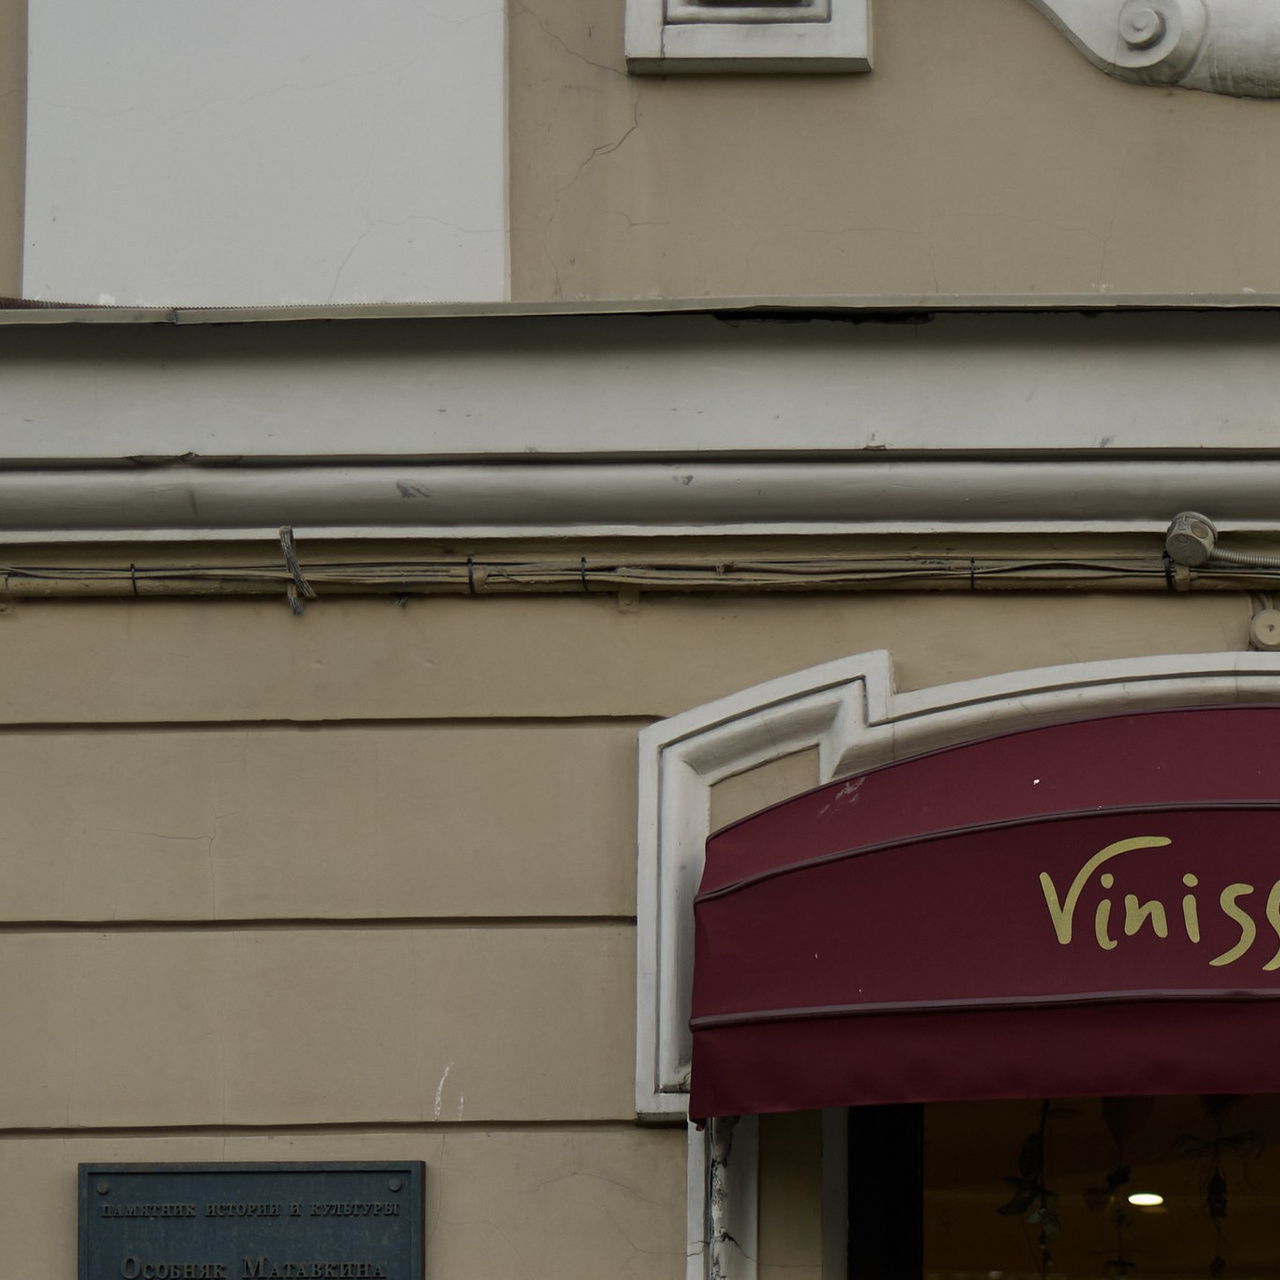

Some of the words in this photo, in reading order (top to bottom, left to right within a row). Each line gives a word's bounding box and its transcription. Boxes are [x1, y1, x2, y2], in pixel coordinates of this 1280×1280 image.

[100, 1203, 196, 1217] ПАМЯТНИК
[205, 1203, 281, 1217] ИСТОРИИ
[290, 1203, 301, 1217] И
[310, 1202, 400, 1217] КУЛЬТУРЫ
